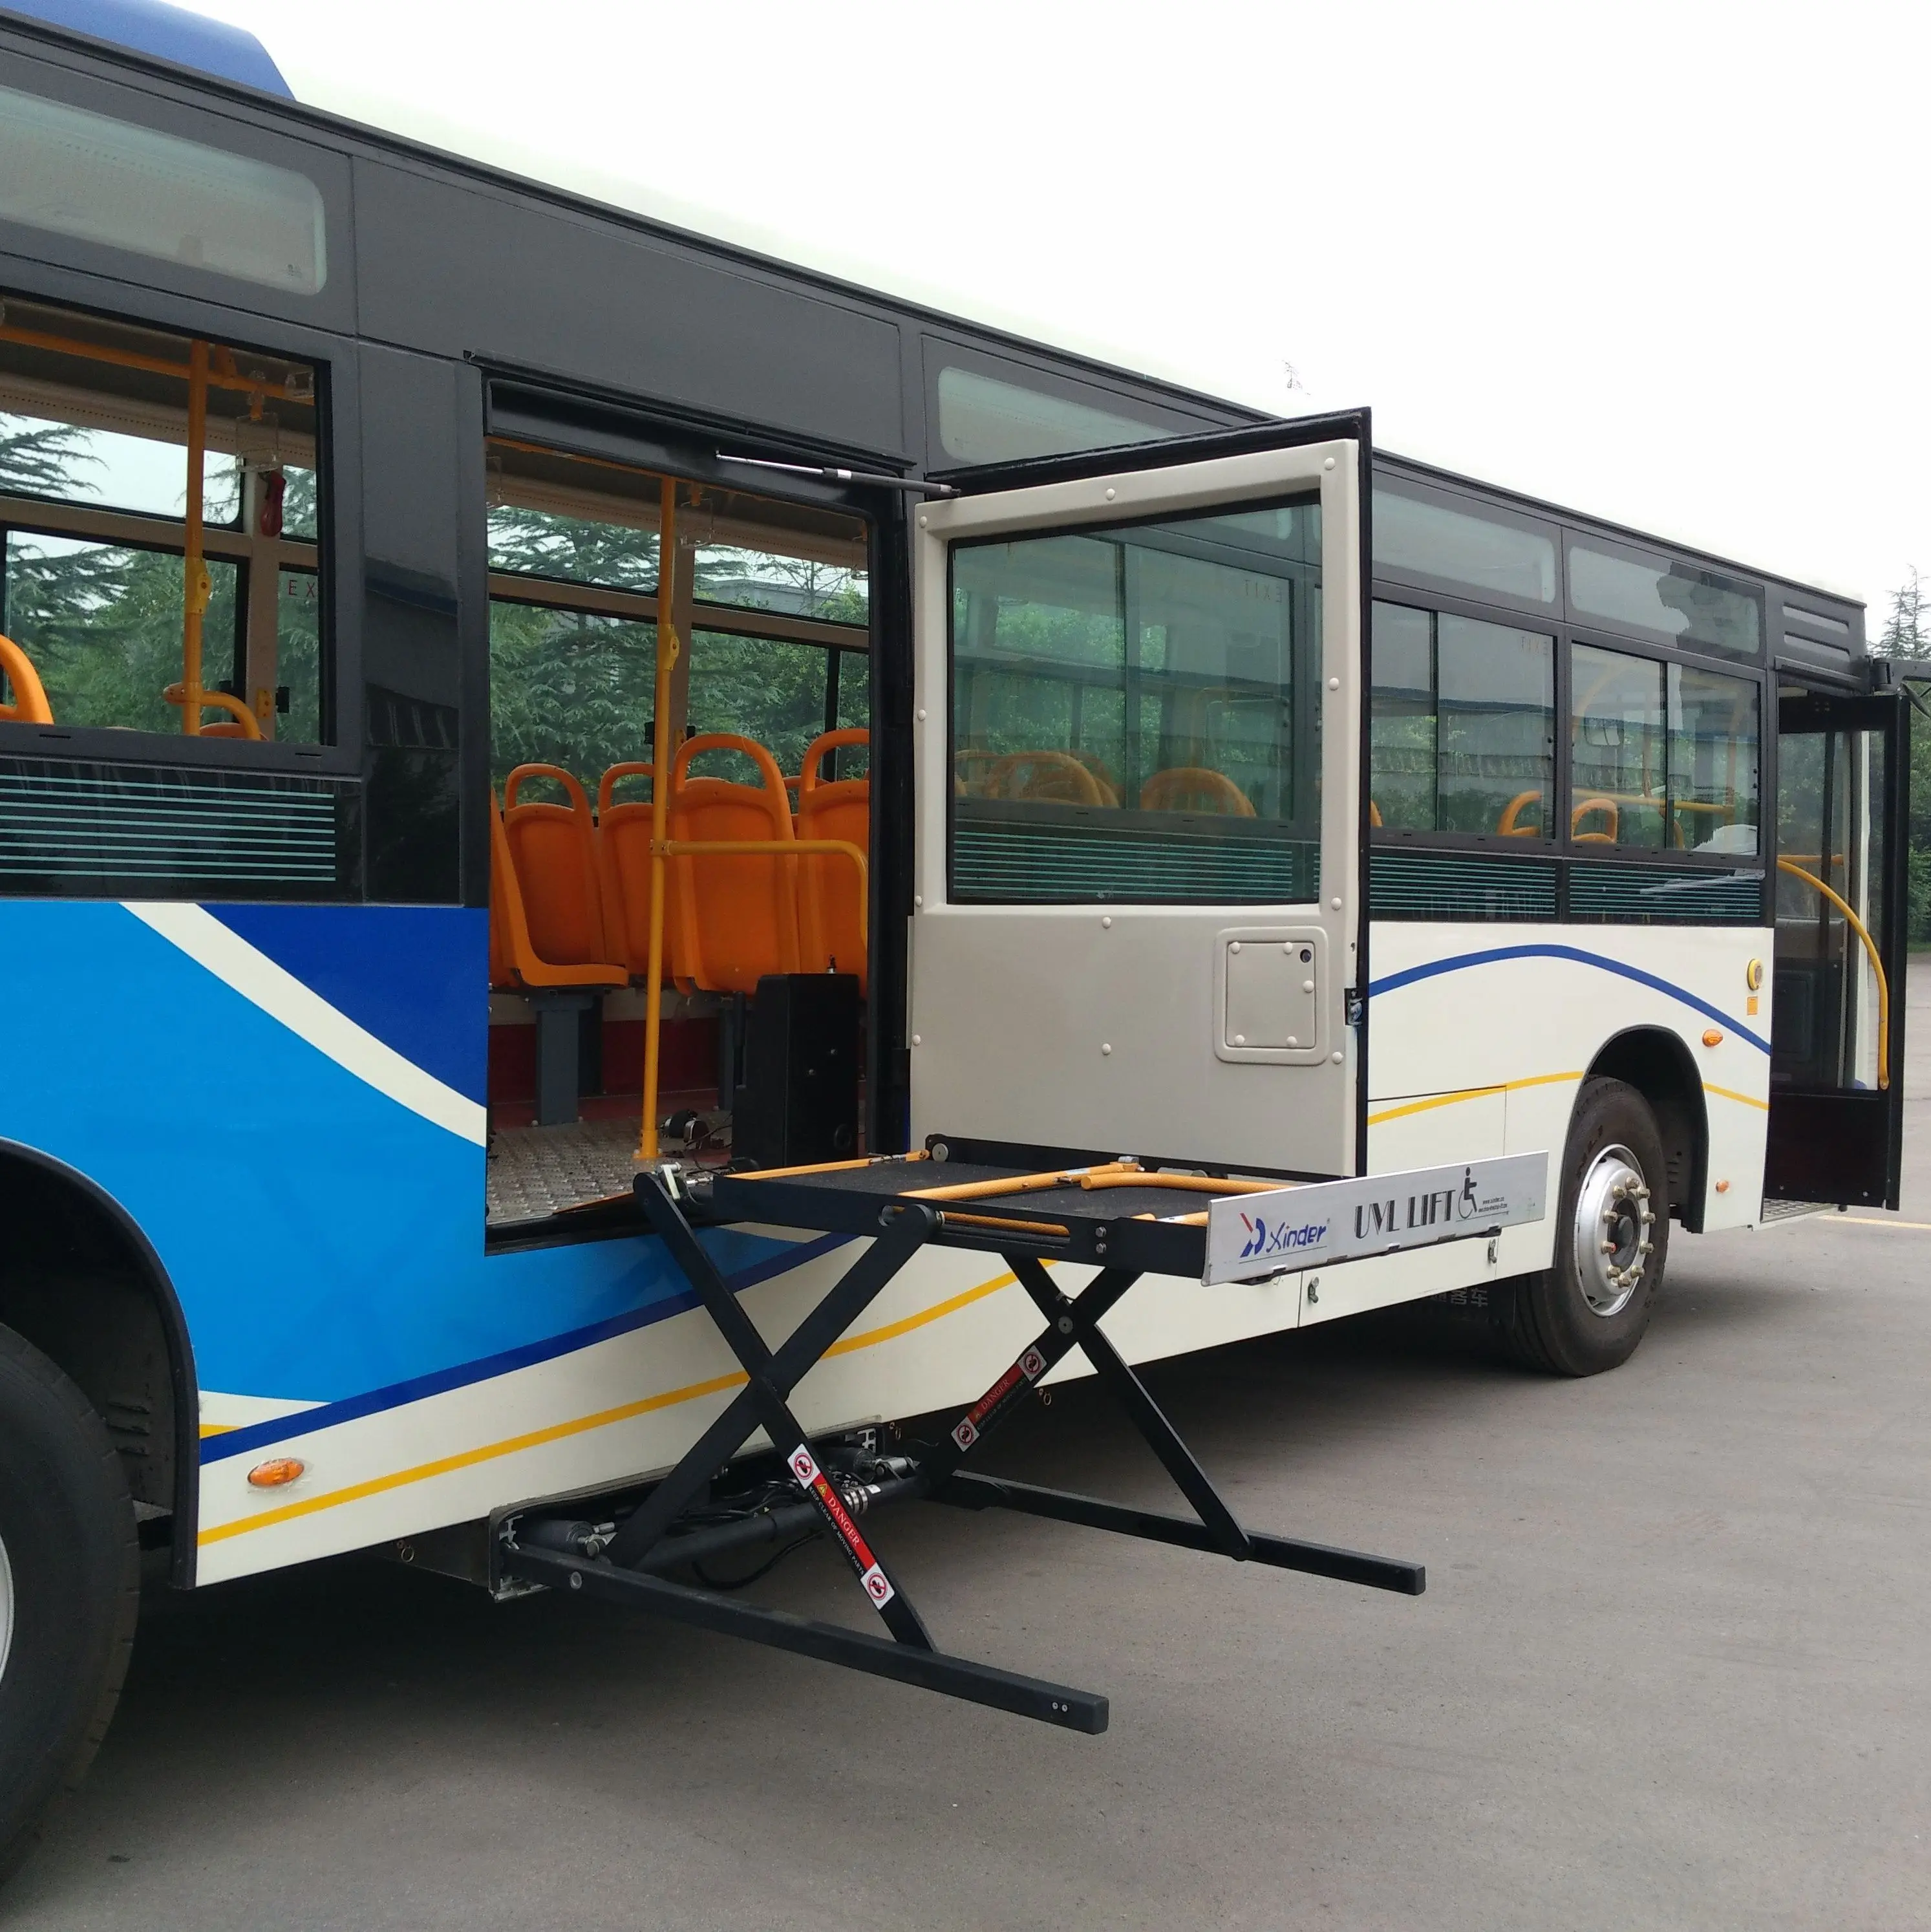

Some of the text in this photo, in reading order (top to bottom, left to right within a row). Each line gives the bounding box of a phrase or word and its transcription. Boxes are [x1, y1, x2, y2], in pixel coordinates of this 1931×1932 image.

[288, 579, 315, 598] EX
[1354, 1189, 1456, 1240] UVL LIFT
[1265, 1221, 1327, 1253] Xinder
[981, 1379, 1010, 1410] DANGER
[809, 1486, 865, 1576] KEEP CLEAR OF MOVING PARTS
[828, 1496, 860, 1547] DANGER
